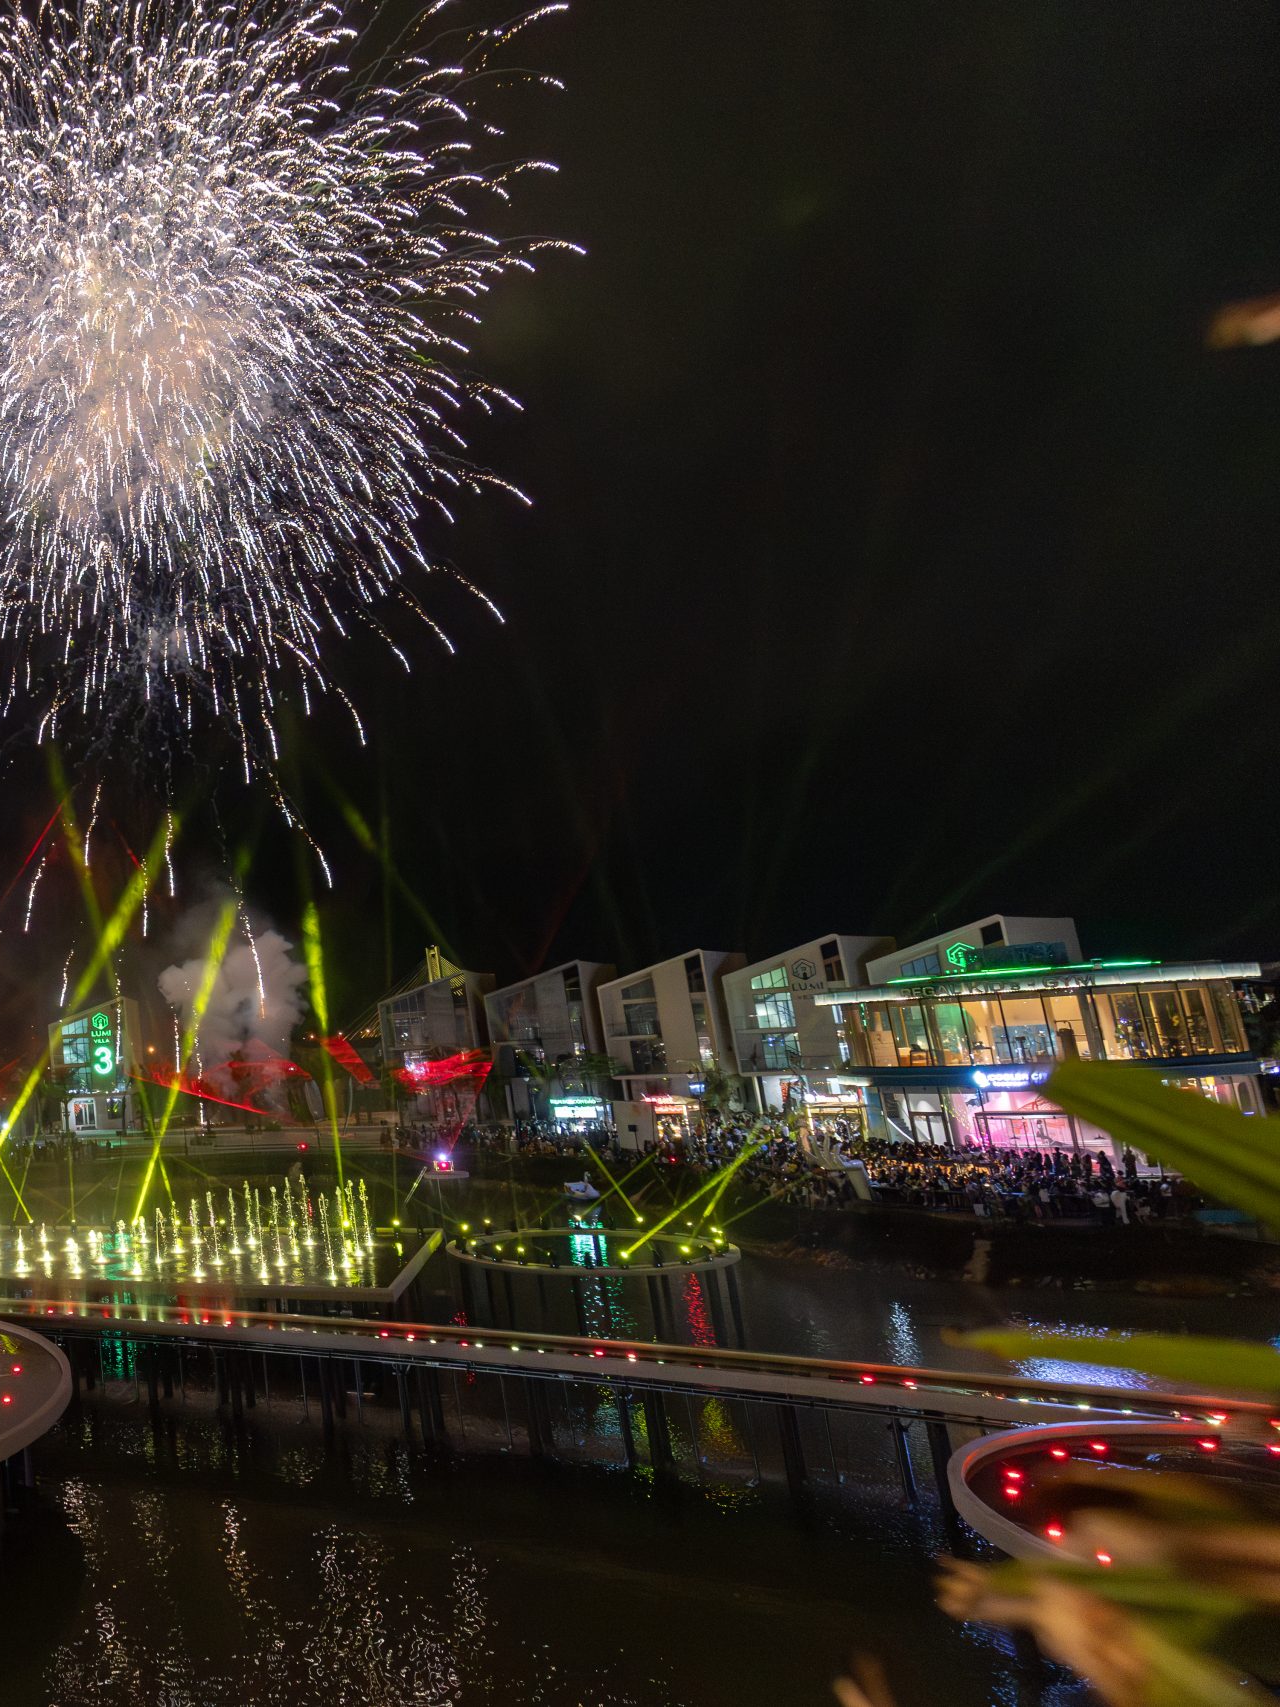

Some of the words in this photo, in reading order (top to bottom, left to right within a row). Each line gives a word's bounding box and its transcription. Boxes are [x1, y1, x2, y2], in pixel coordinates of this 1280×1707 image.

[791, 982, 824, 991] LUMI
[901, 983, 963, 998] REGAL
[1042, 975, 1096, 989] GYM
[94, 1047, 112, 1074] 3
